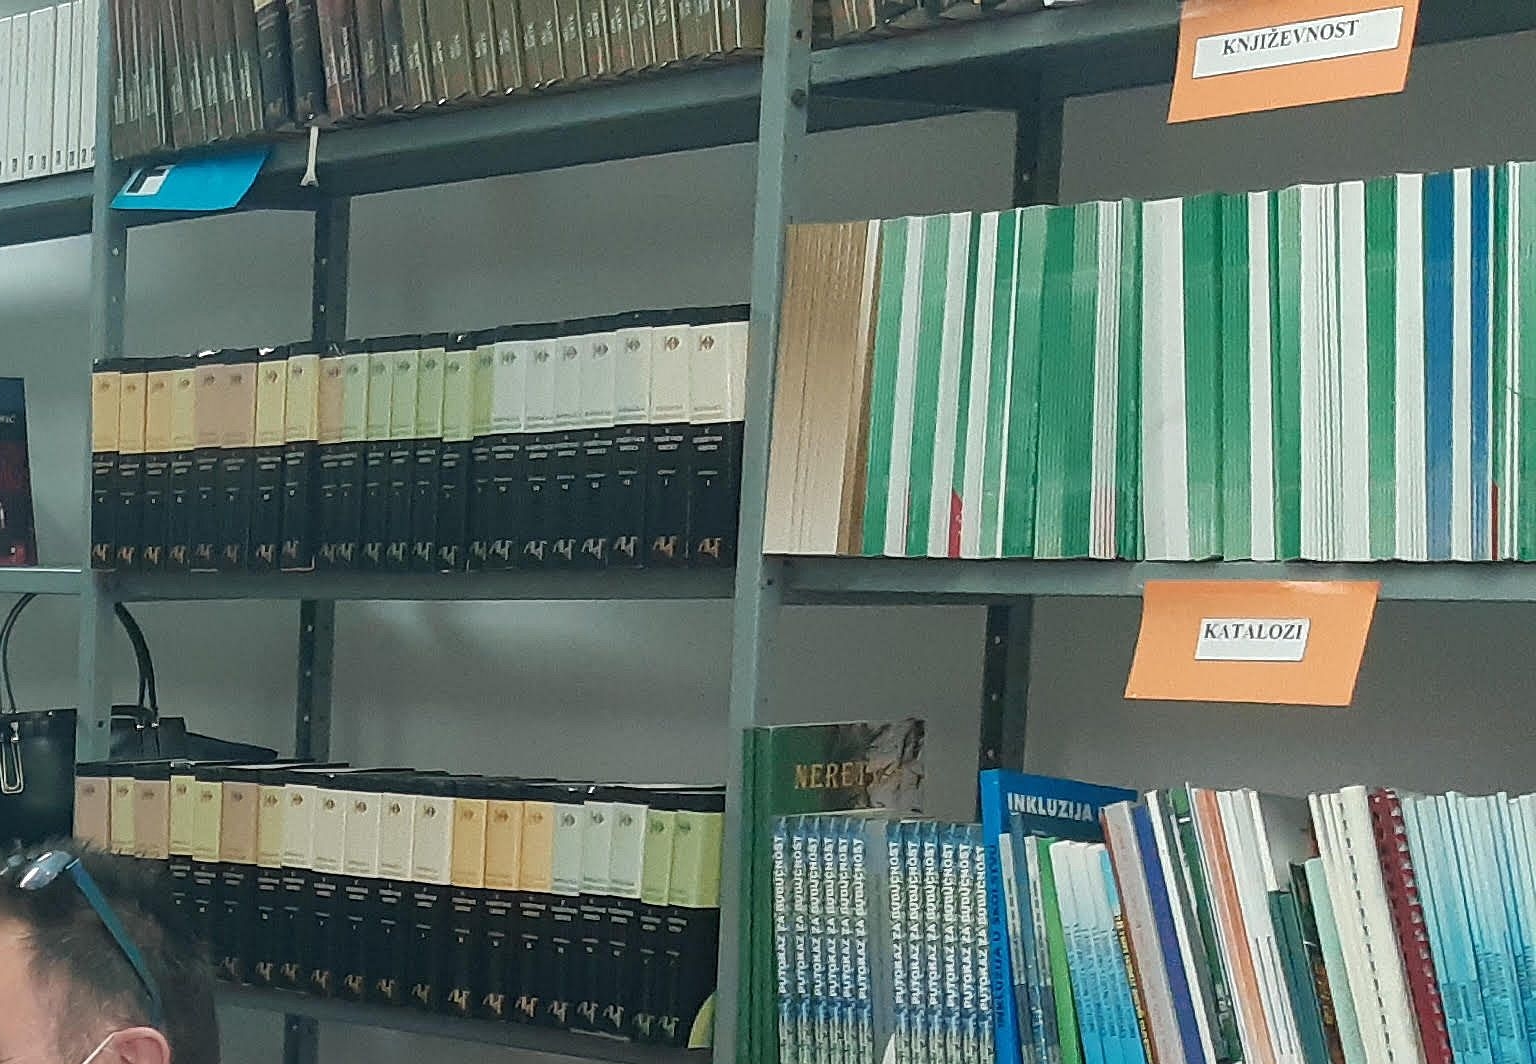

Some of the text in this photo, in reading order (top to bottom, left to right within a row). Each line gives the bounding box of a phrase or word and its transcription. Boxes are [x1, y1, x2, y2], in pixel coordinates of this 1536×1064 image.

[1221, 18, 1360, 57] KNJIŽEVNOST
[1204, 623, 1303, 640] KATALOZI
[1007, 792, 1094, 822] INKLUZIJA
[777, 935, 787, 994] PUTOKAZ
[796, 935, 807, 994] PUTOKAZ
[812, 937, 823, 996] PUTOKAZ
[827, 937, 839, 997] PUTOKAZ
[841, 938, 852, 997] PUTOKAZ
[856, 939, 868, 999] PUTOKAZ
[893, 941, 905, 1004] PUTOKAZ
[911, 942, 922, 1005] PUTOKAZ
[928, 942, 939, 1005] PUTOKAZ
[945, 943, 957, 1007] PUTOKAZ
[962, 946, 974, 1009] PUTOKAZ
[978, 948, 990, 1010] PUTOKAZ
